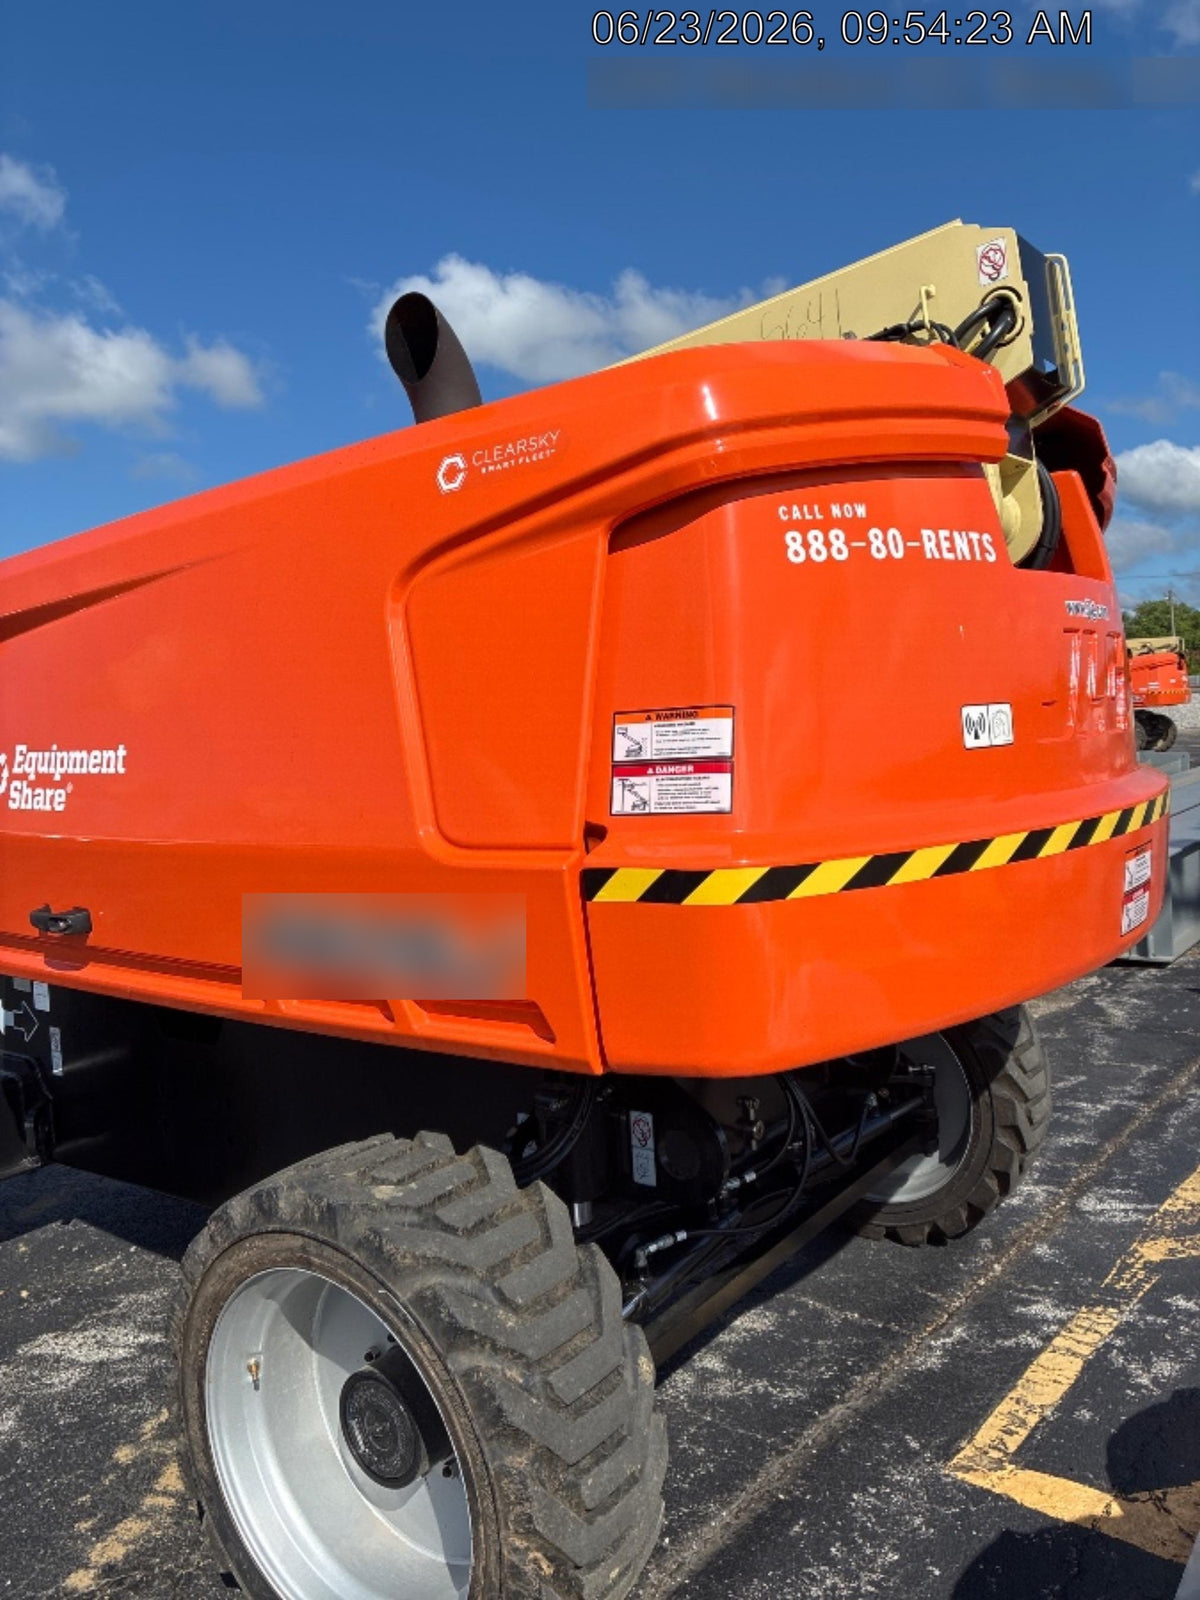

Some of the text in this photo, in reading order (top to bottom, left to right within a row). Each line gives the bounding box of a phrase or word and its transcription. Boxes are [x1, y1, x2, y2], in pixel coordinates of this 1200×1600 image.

[471, 429, 561, 466] CLEARSKY
[480, 459, 516, 474] SMART
[778, 503, 867, 520] CALL NOW
[784, 527, 997, 563] 888-80-RENTS
[655, 711, 699, 720] WARNING
[12, 743, 127, 781] Equipment
[655, 765, 694, 774] DANGER
